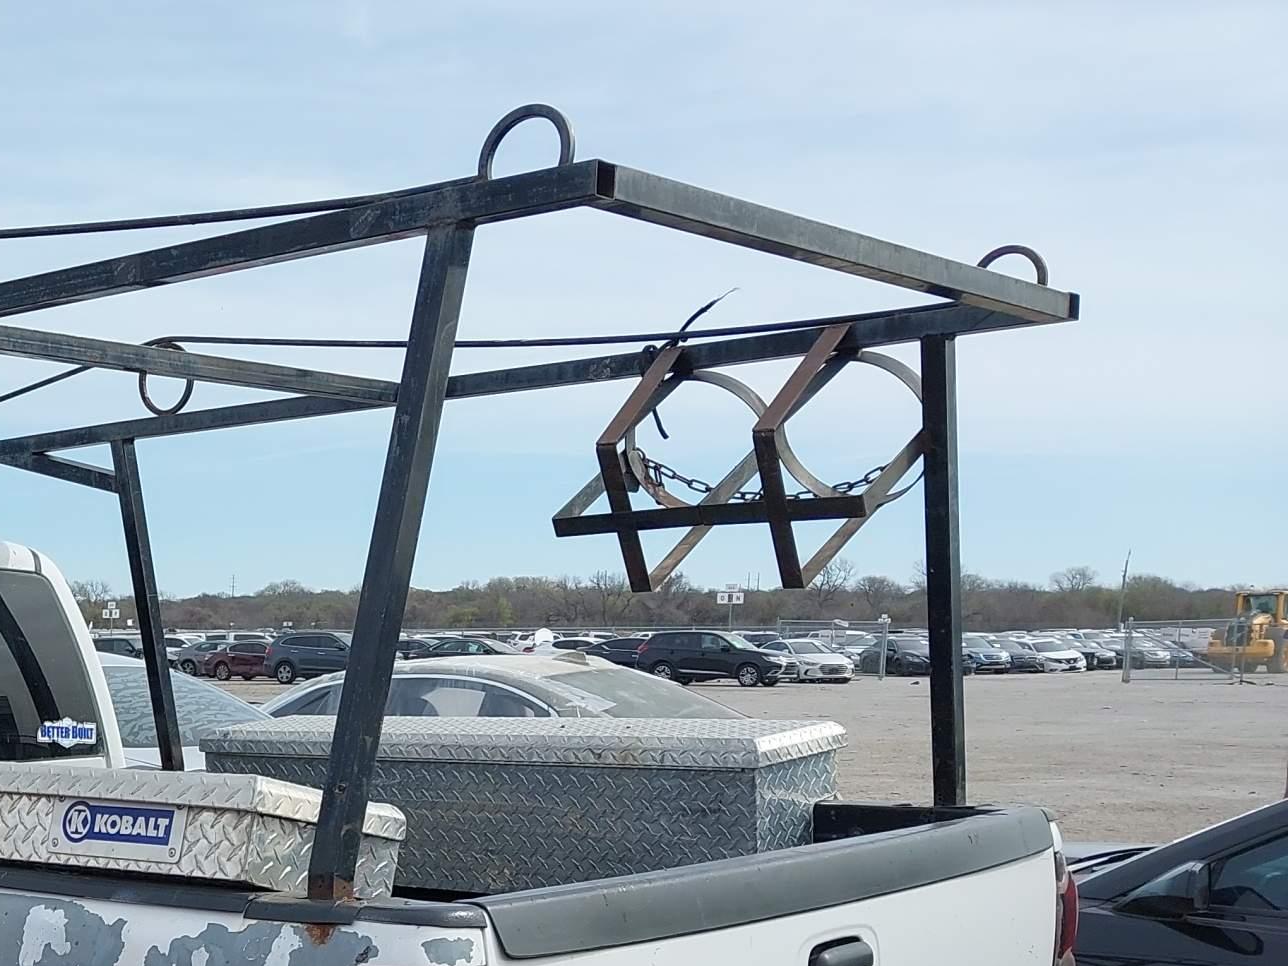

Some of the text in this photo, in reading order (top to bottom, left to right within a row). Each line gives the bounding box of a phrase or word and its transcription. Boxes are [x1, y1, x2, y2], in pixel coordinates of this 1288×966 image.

[39, 724, 94, 740] BETTER BUILT
[93, 813, 170, 838] KOBALT
